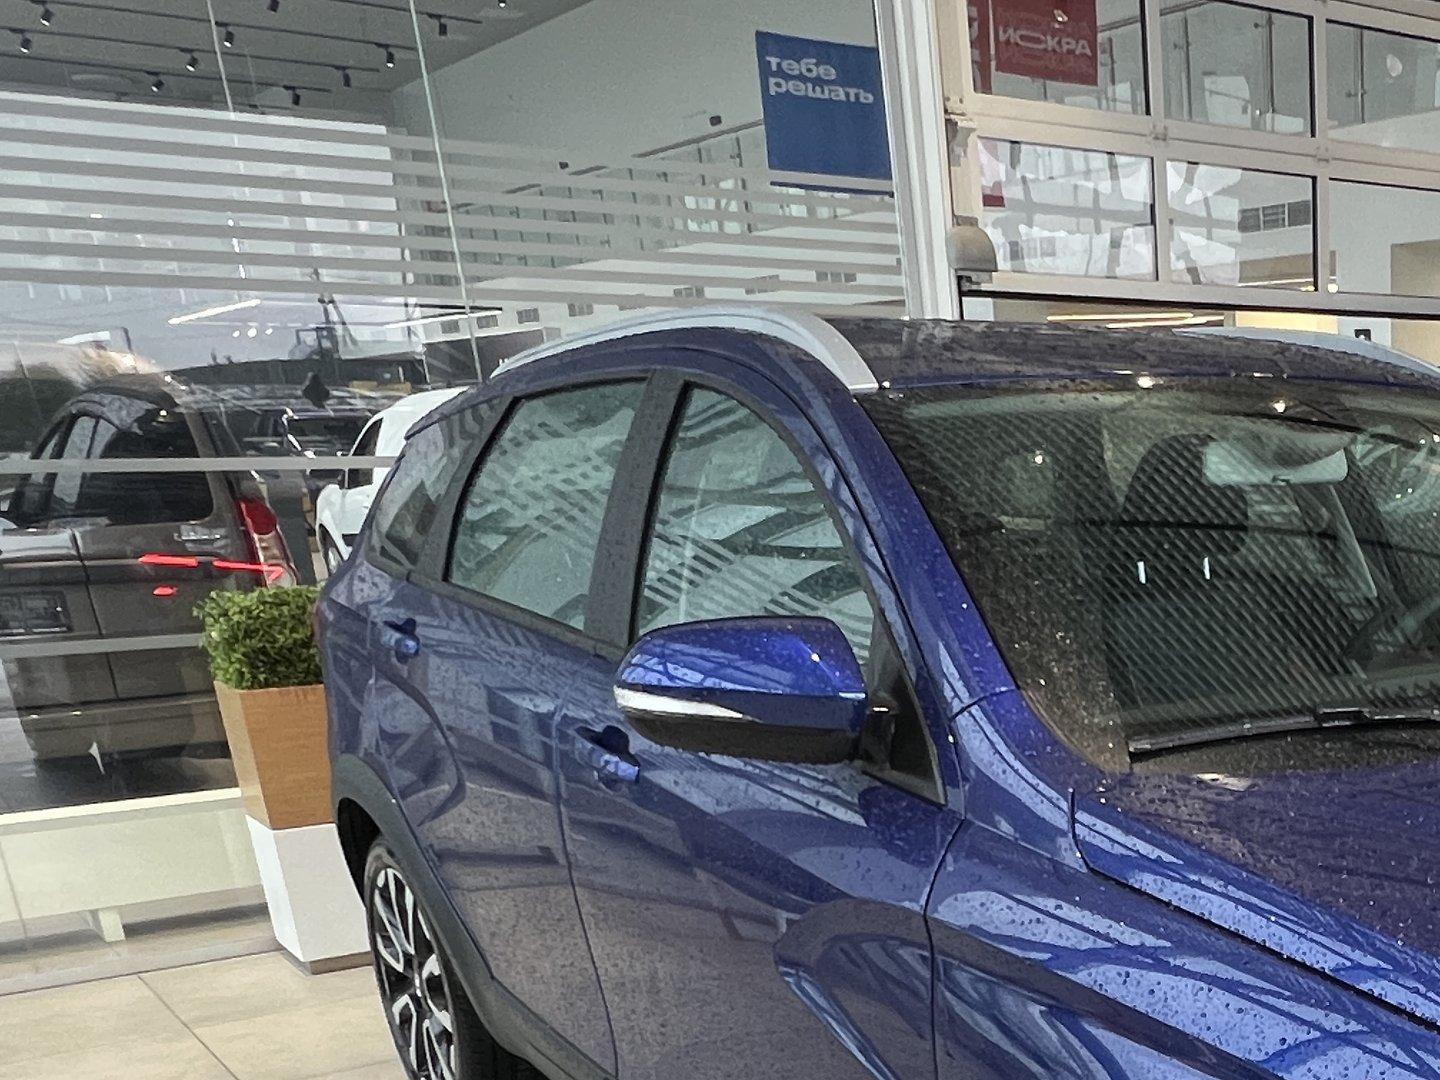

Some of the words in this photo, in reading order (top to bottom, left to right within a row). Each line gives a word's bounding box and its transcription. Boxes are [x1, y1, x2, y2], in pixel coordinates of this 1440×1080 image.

[998, 26, 1092, 57] ИСКРА
[765, 56, 837, 80] тебе
[768, 77, 874, 104] решать
